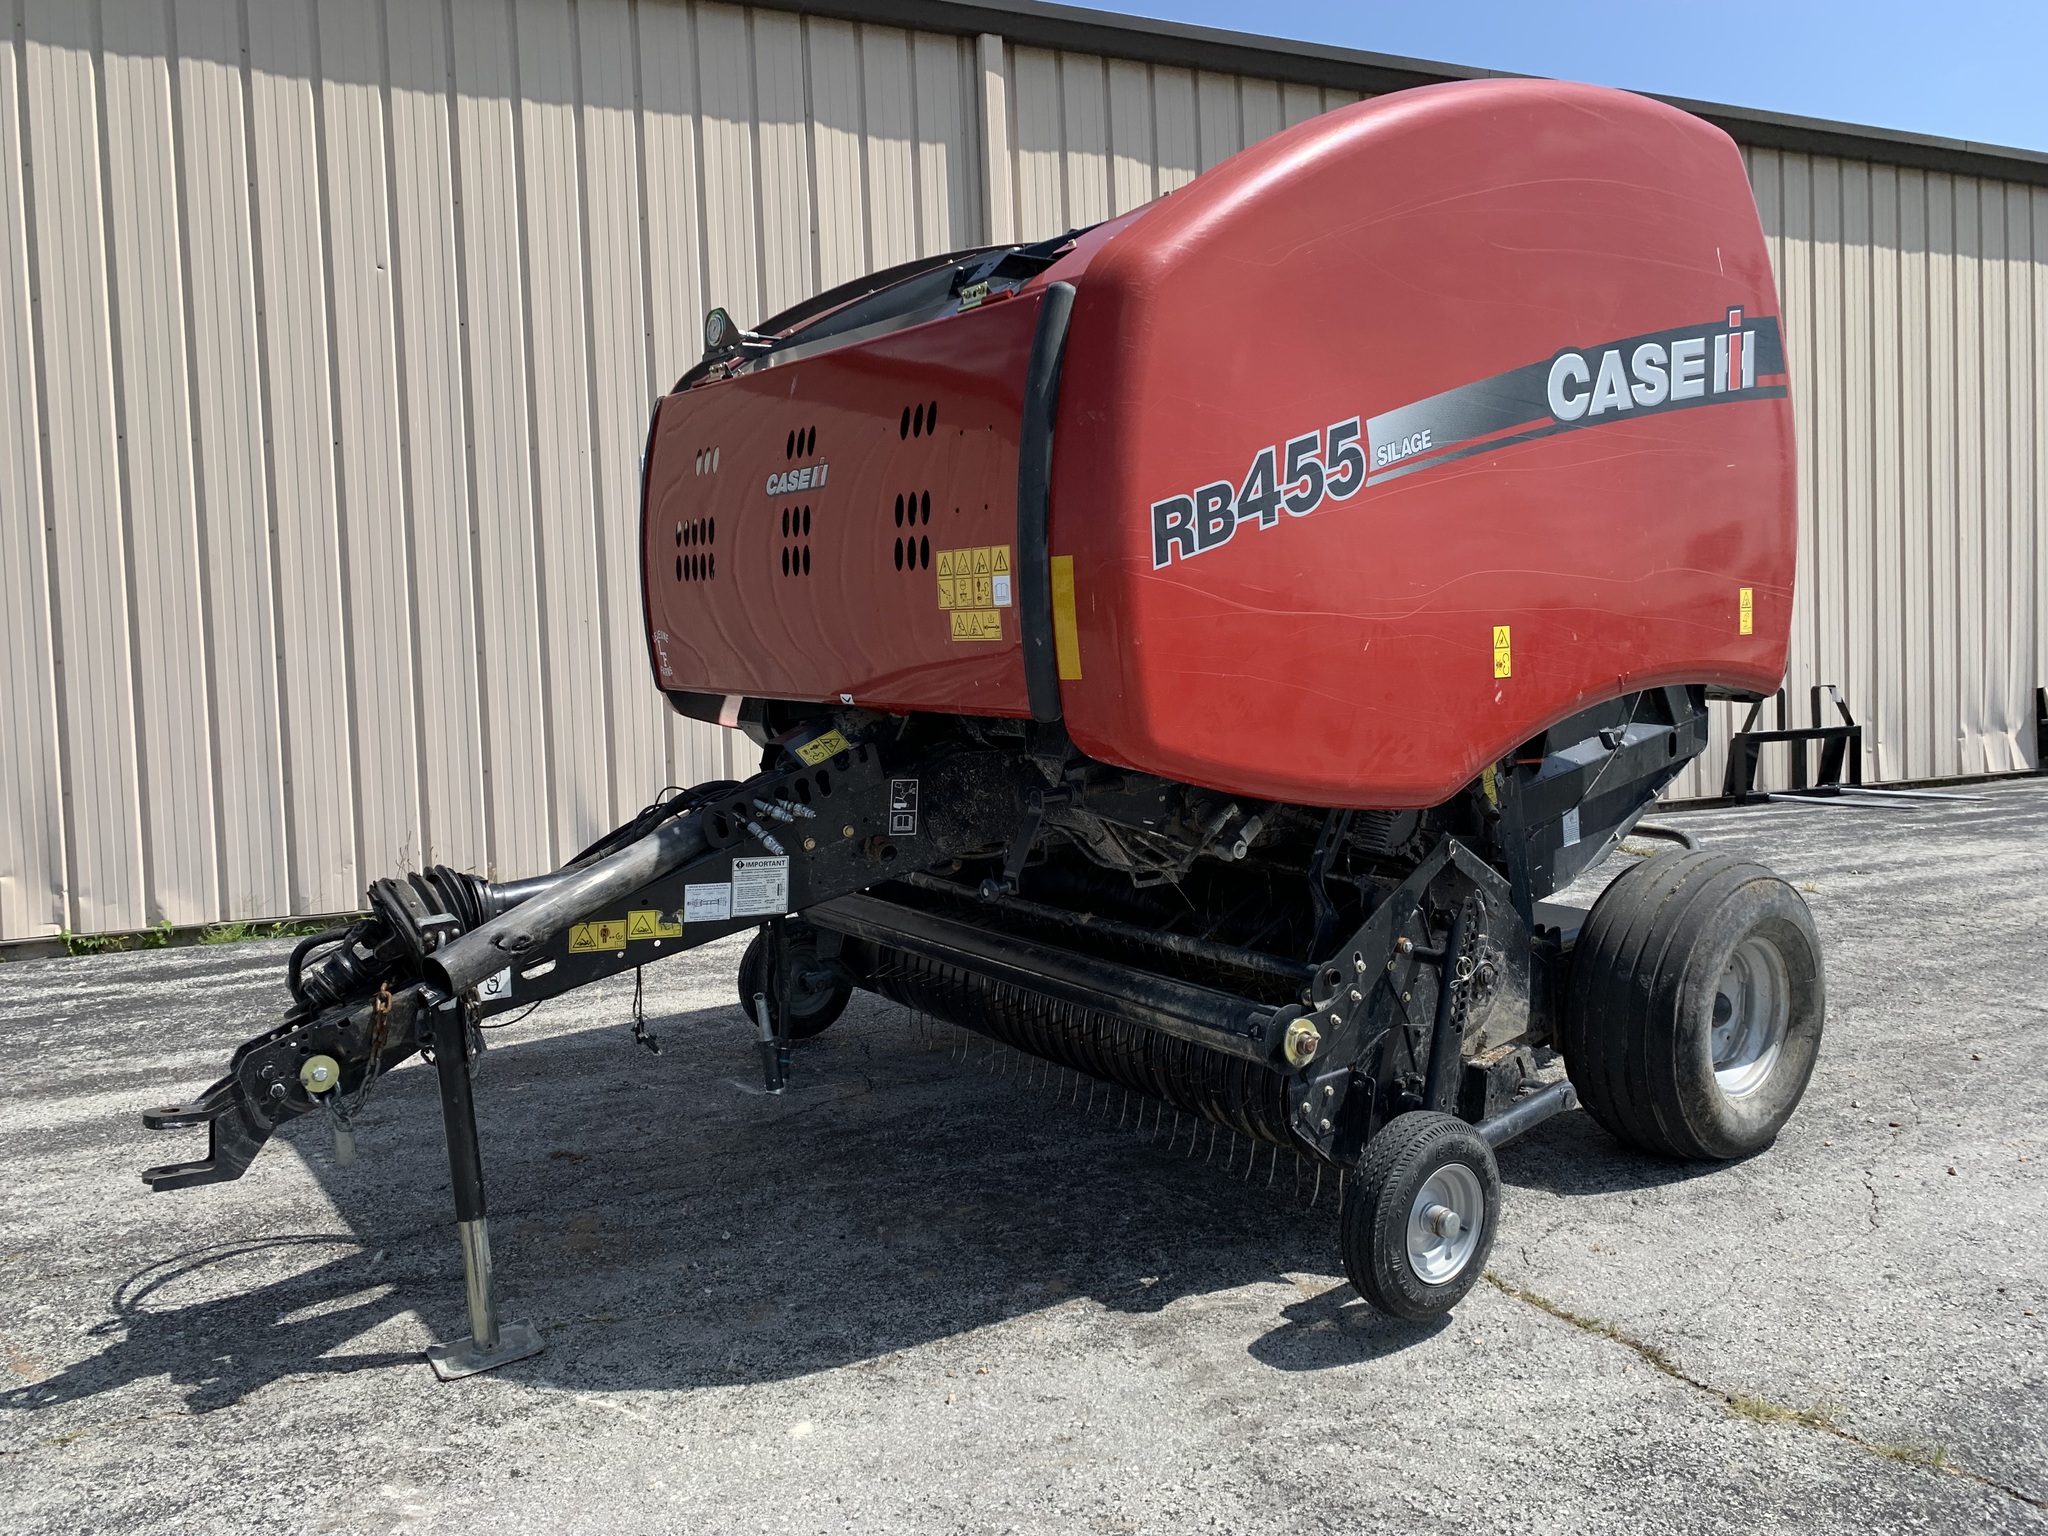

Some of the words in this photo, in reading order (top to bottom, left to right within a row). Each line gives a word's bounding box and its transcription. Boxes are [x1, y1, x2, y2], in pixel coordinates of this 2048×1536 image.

[1376, 429, 1432, 466] SILAGE
[1151, 416, 1366, 570] RB455
[745, 859, 786, 868] IMPORTANT
